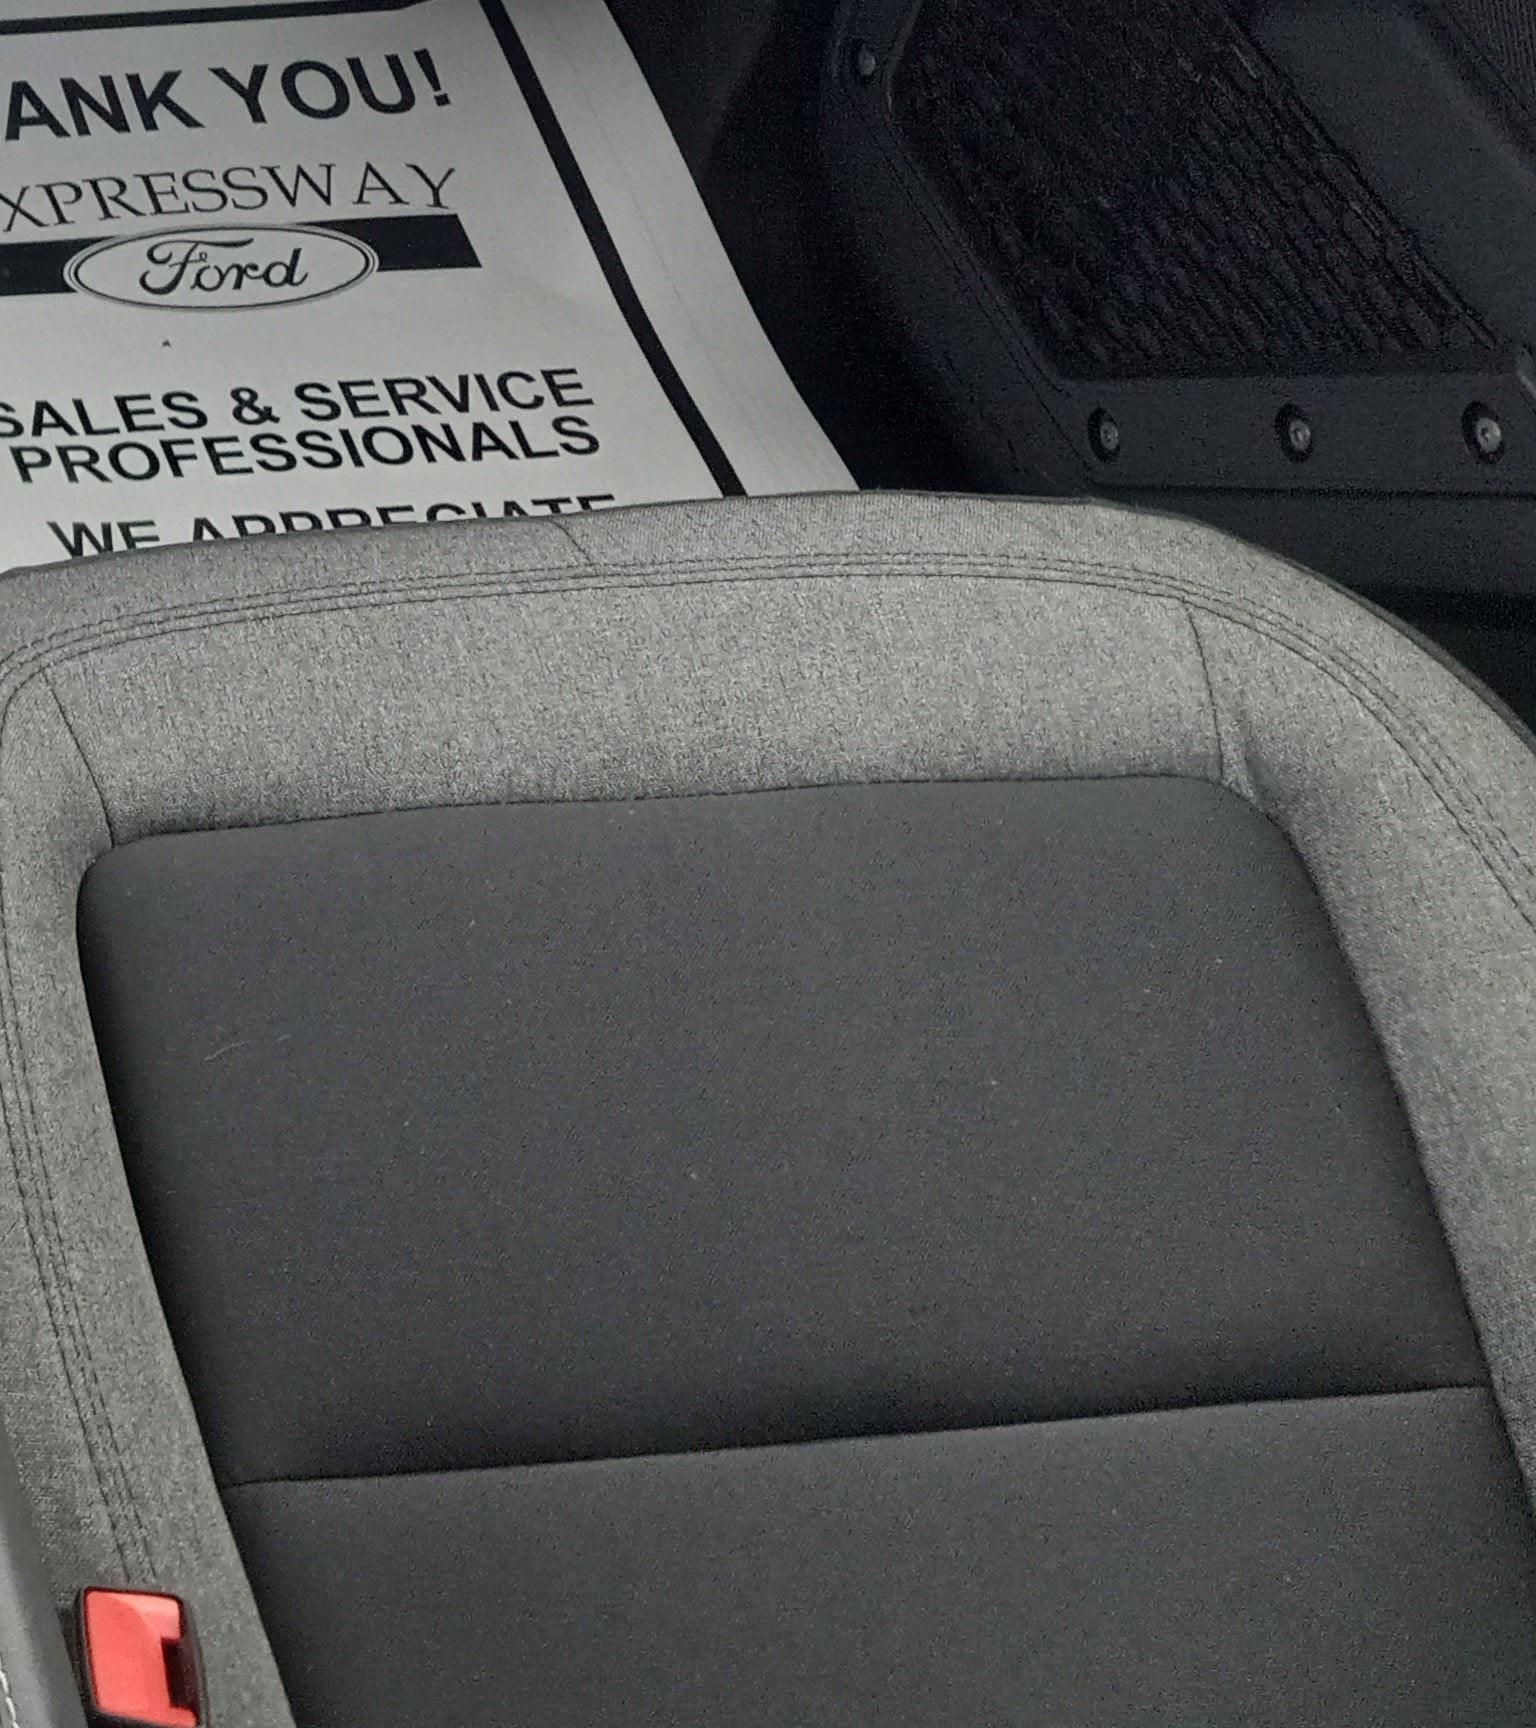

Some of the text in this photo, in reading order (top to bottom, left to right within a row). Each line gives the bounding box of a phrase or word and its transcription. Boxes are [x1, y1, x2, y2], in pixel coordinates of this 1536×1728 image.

[208, 48, 452, 124] YOU!
[138, 236, 309, 296] Ford
[230, 386, 281, 425] &
[294, 367, 596, 423] SERVICE
[8, 415, 602, 484] PROFESSIONALS
